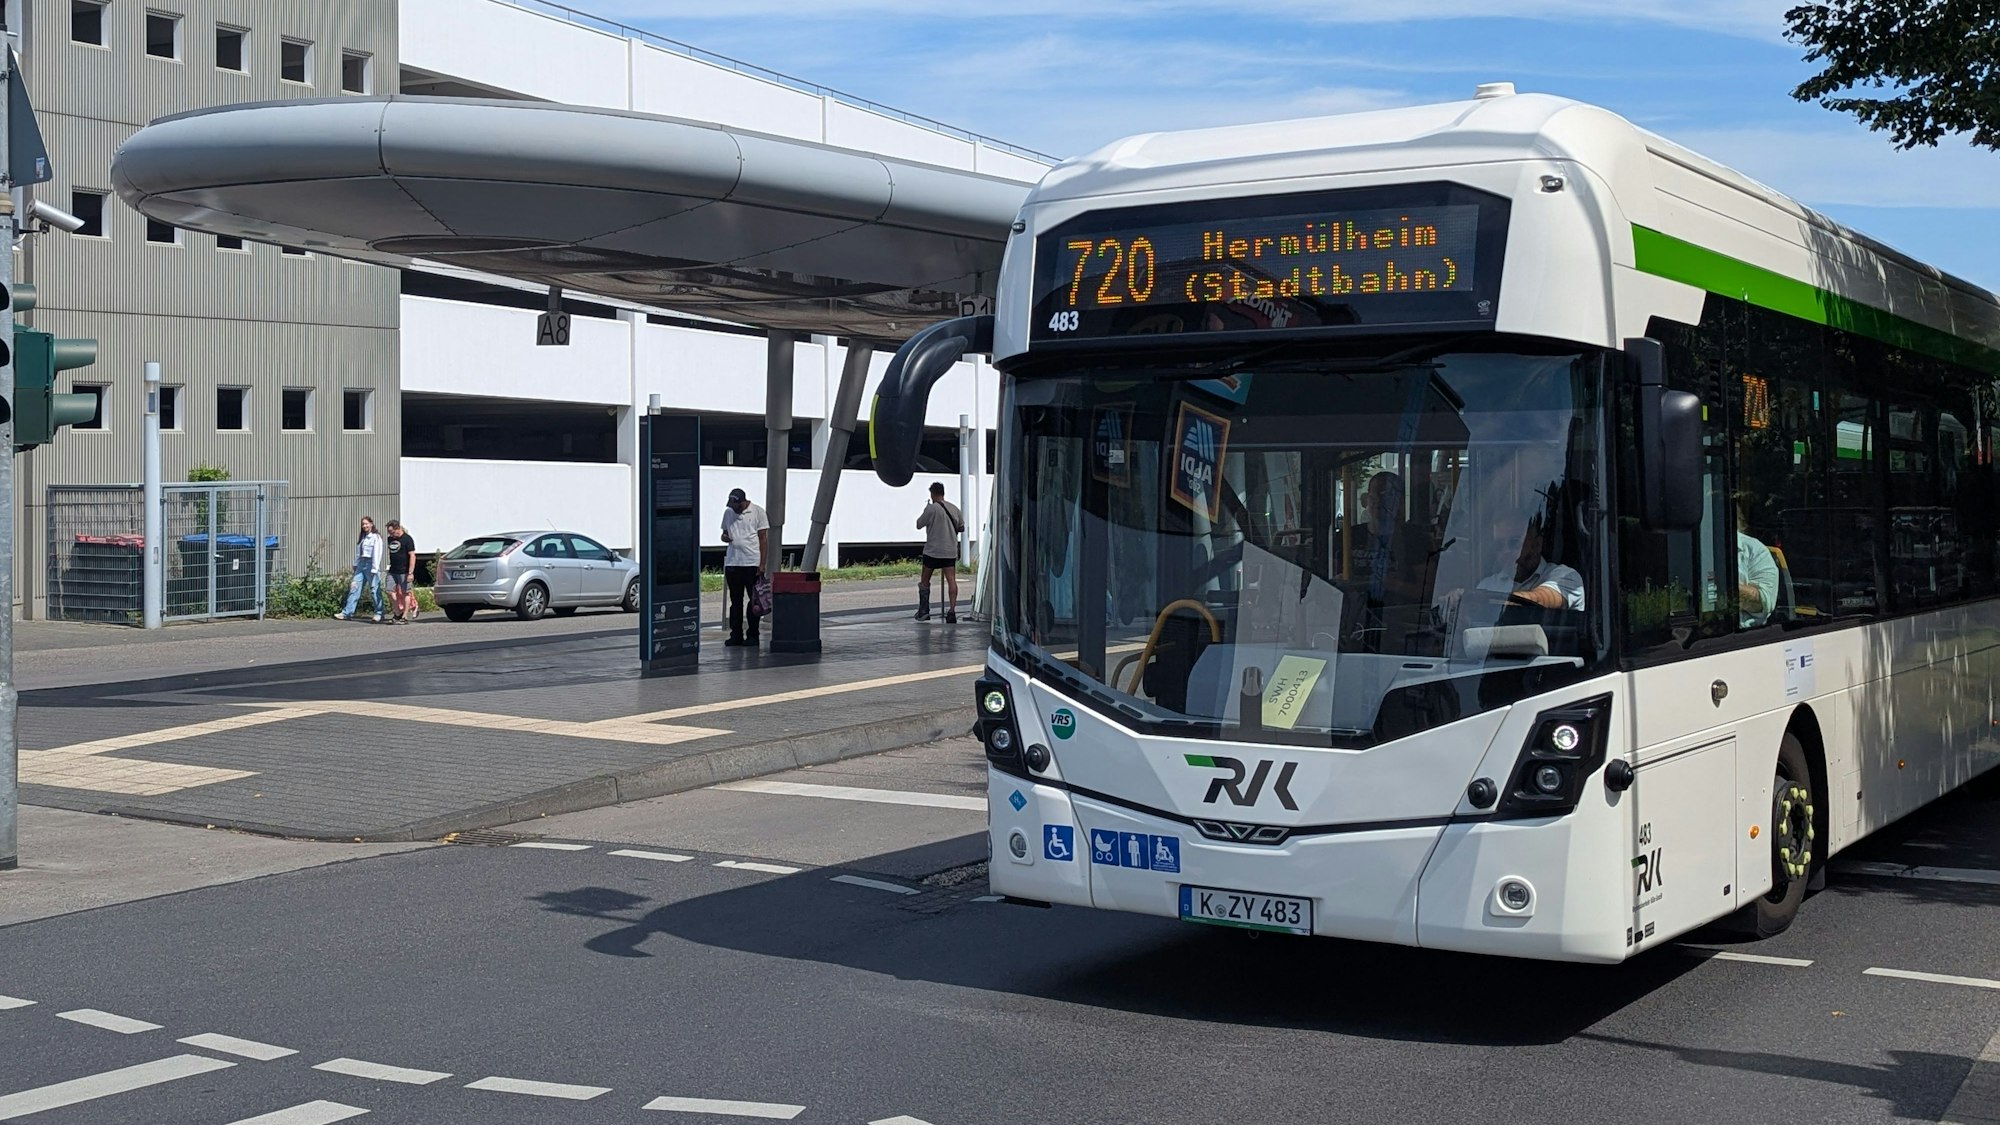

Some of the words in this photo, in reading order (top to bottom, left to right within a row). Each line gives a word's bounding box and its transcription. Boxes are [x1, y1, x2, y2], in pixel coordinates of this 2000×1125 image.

[1203, 215, 1437, 260] Hermülheim
[1067, 236, 1154, 305] 720
[1186, 257, 1456, 302] (Stadtbahn)
[539, 315, 568, 344] A8
[1048, 310, 1080, 332] 483
[1269, 678, 1288, 704] SWH
[1278, 670, 1309, 716] 7000413
[1051, 713, 1070, 725] VRS
[1639, 822, 1651, 847] 483
[1200, 892, 1213, 916] K
[1228, 896, 1256, 920] ZY
[1260, 899, 1301, 925] 483
